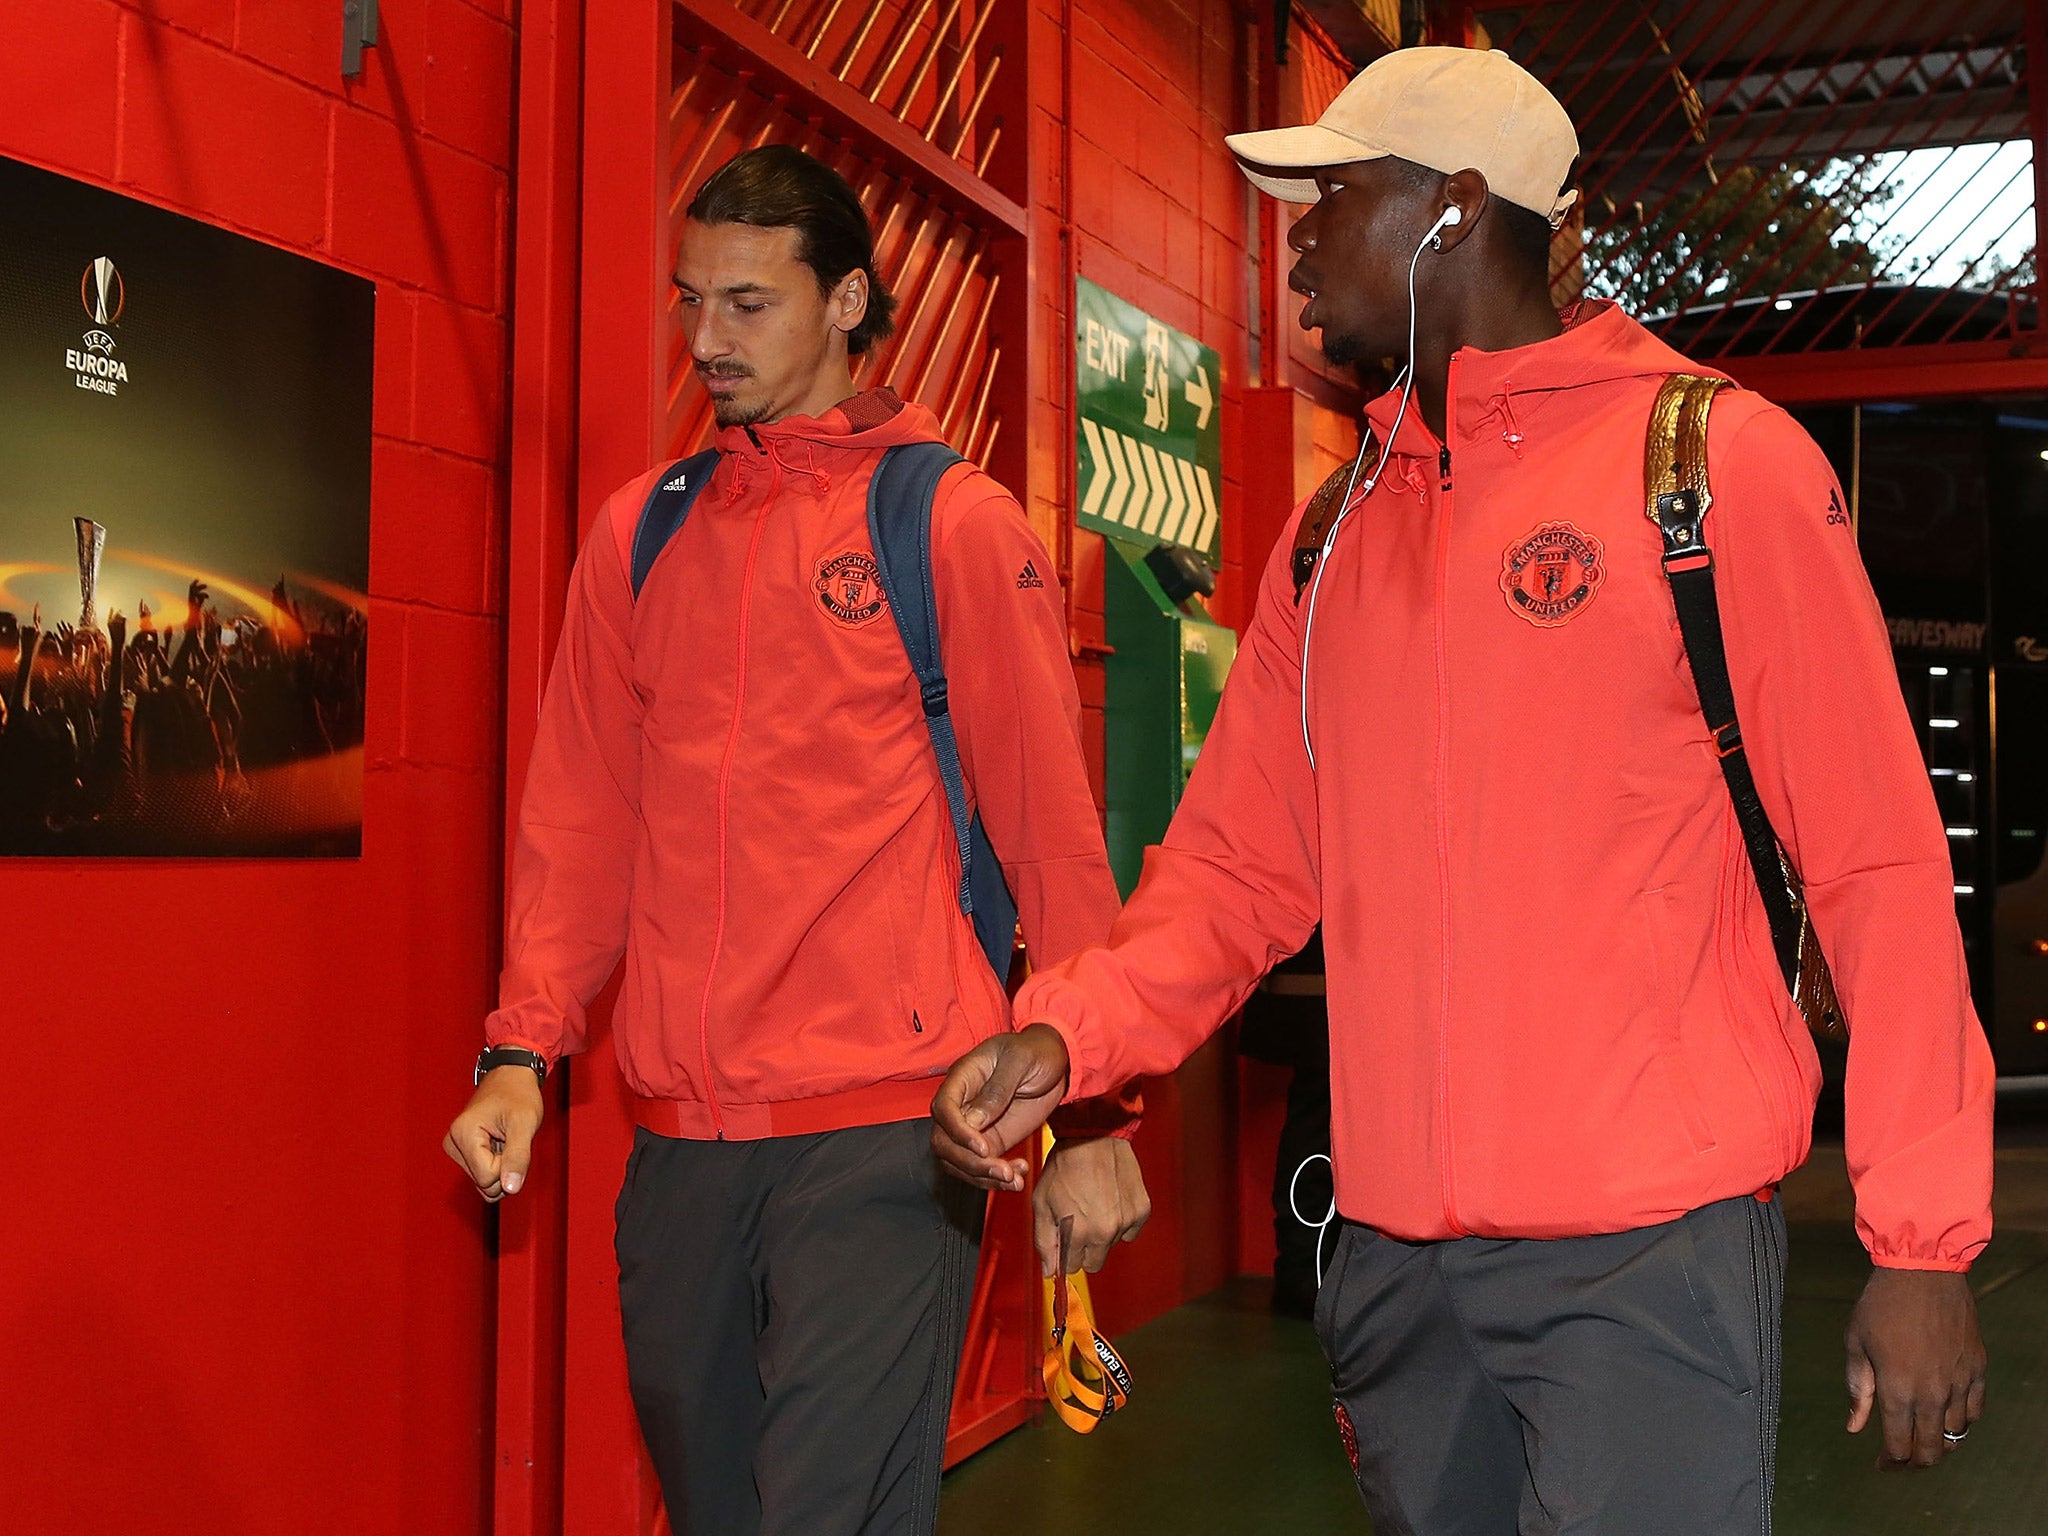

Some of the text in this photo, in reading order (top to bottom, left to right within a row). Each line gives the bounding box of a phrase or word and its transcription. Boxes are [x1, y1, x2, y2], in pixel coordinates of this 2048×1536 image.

[84, 333, 114, 354] UEFA
[1086, 319, 1130, 382] EXIT
[66, 349, 129, 383] EUROPA
[76, 373, 118, 397] LEAGUE
[1516, 532, 1590, 565] MANCHESTER
[830, 602, 871, 619] UNITED
[1525, 598, 1577, 615] UNITED
